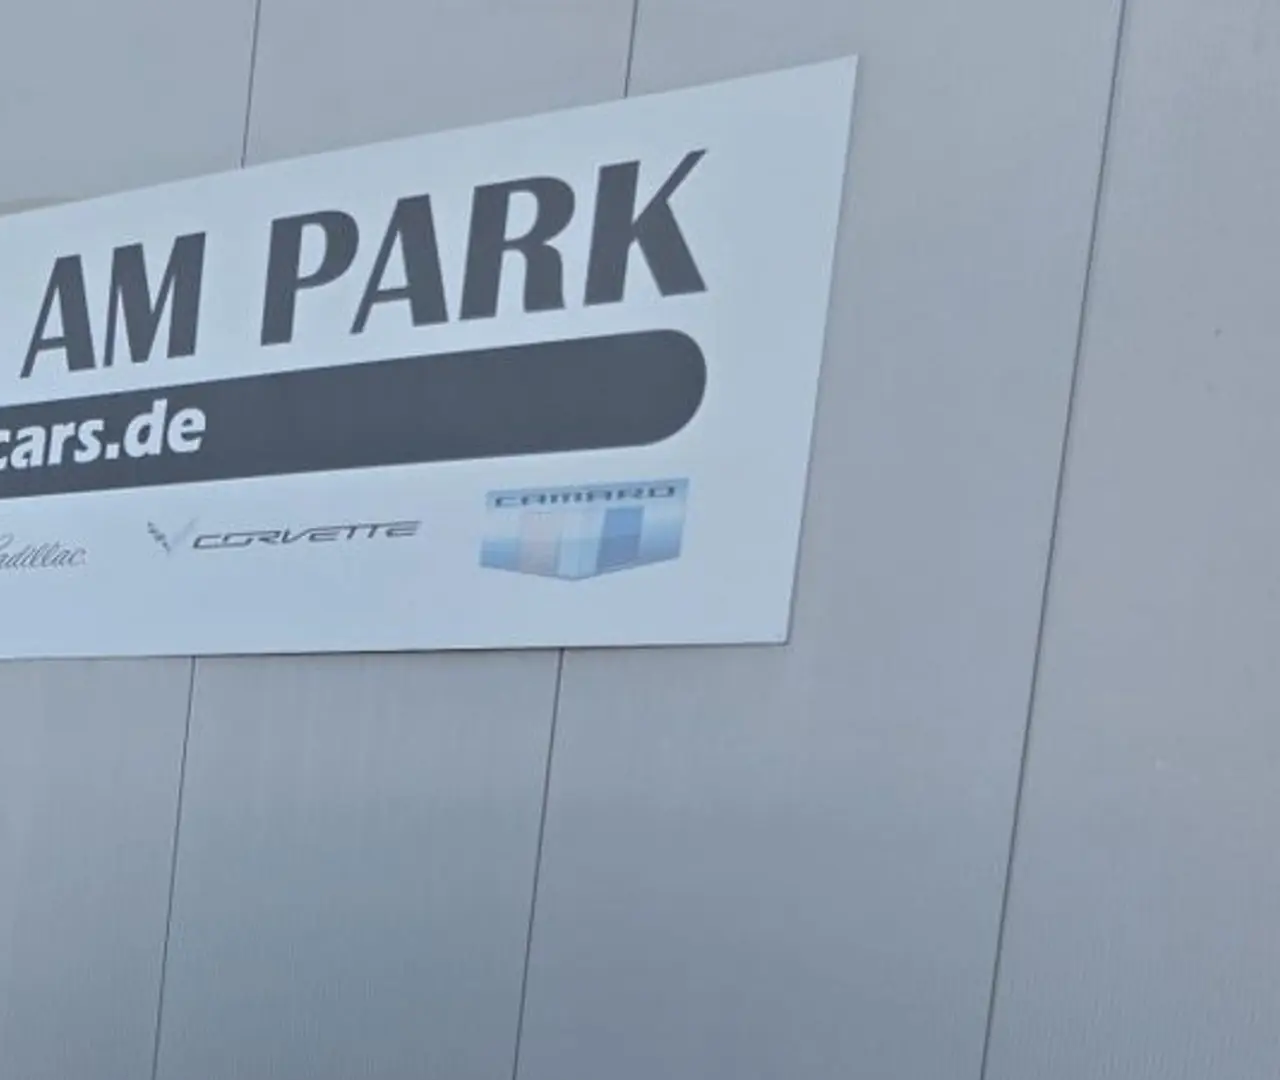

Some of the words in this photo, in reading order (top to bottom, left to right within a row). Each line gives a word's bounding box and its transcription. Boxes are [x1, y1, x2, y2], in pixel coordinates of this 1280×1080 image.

[20, 231, 206, 379] AM
[260, 149, 707, 346] PARK
[493, 482, 678, 508] CAMARO
[192, 520, 422, 551] CORVETTE
